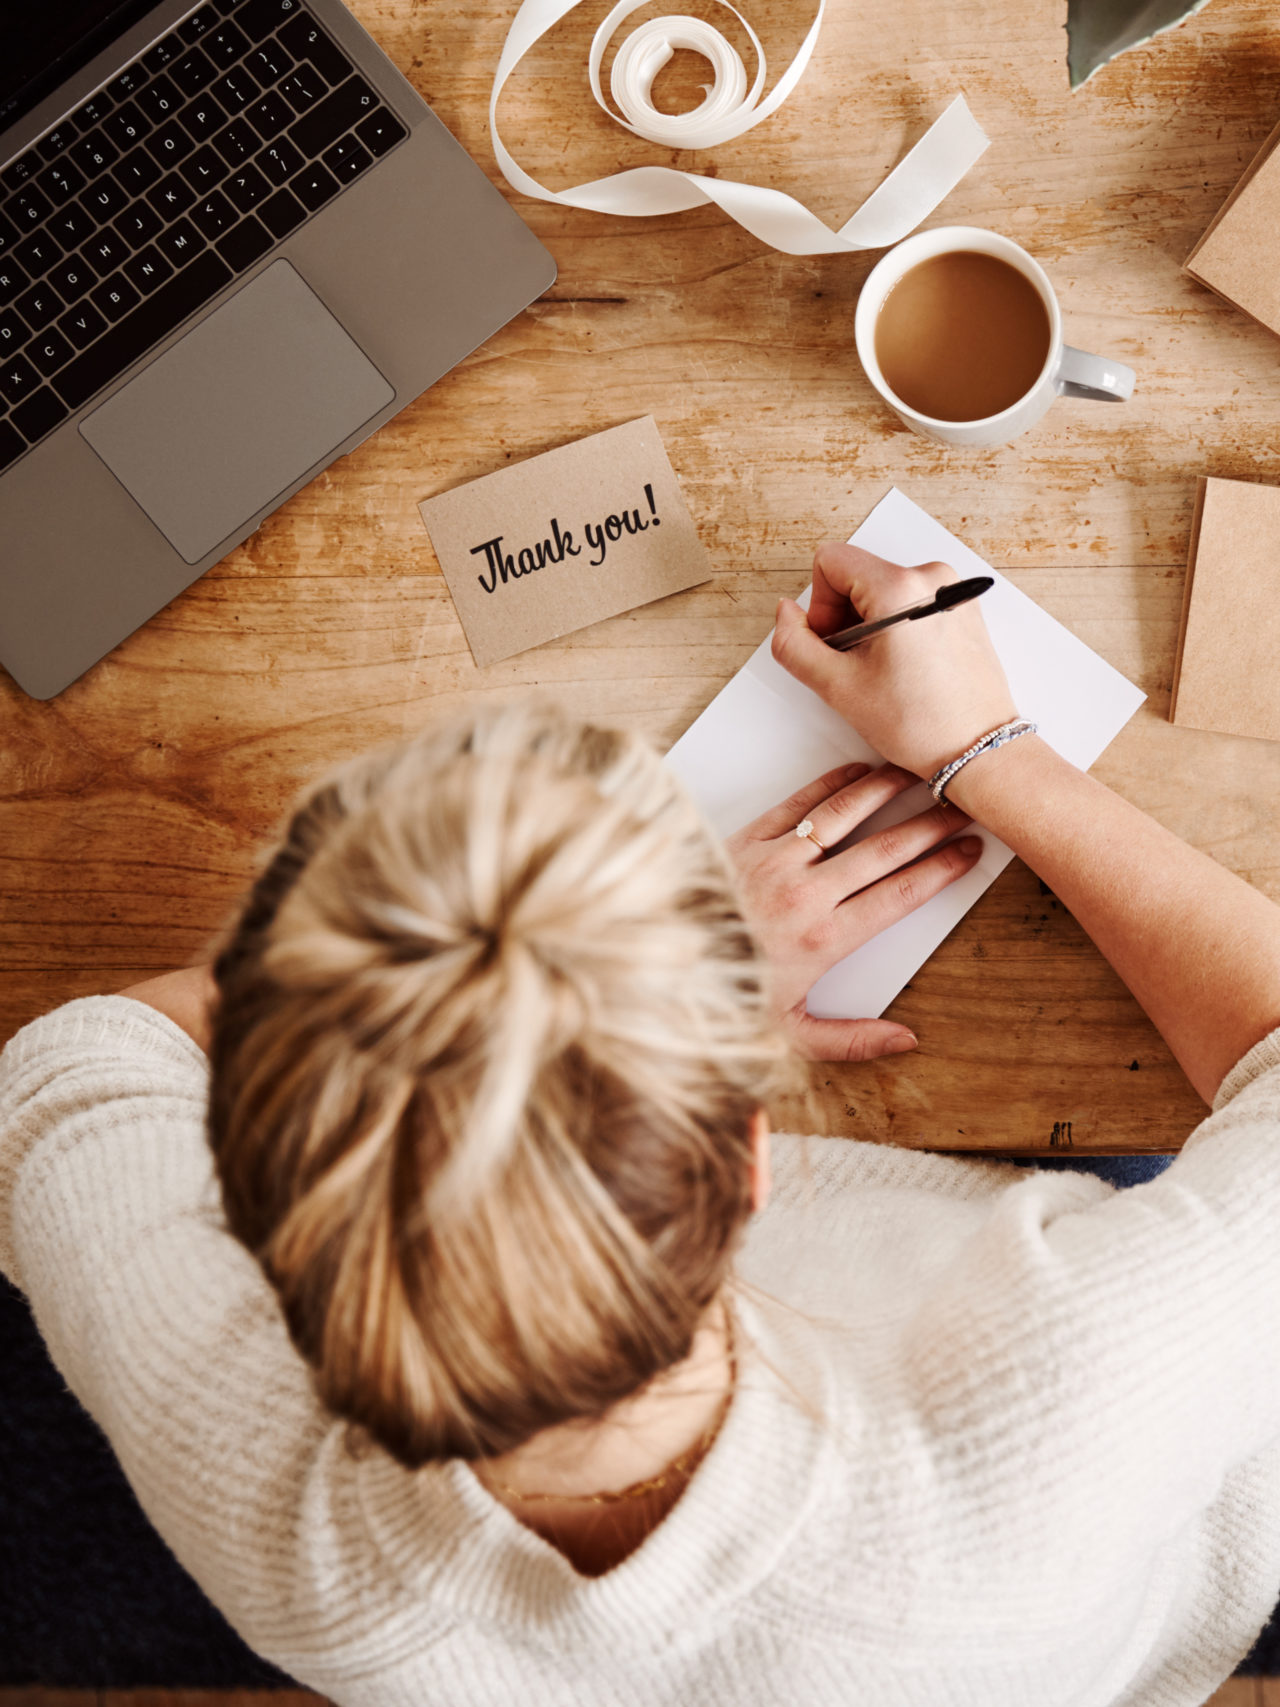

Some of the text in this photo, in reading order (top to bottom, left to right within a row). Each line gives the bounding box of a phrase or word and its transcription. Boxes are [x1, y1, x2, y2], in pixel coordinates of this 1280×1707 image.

[160, 100, 168, 109] 0
[197, 112, 205, 122] P
[127, 127, 136, 136] 9
[165, 139, 174, 149] O
[94, 154, 103, 163] 8
[270, 150, 278, 159] ?
[199, 167, 209, 175] L
[98, 193, 109, 204] U
[166, 191, 176, 202] K
[28, 209, 37, 218] 6
[66, 221, 74, 230] Y
[175, 236, 187, 248] M
[33, 248, 41, 257] T
[100, 246, 111, 256] H
[142, 264, 154, 275] N
[0, 276, 10, 286] R
[68, 274, 77, 283] G
[110, 292, 120, 302] B
[77, 318, 86, 328] V
[1, 328, 11, 338] D
[45, 346, 54, 356] C
[11, 373, 22, 384] X
[470, 484, 660, 593] Thank you!
